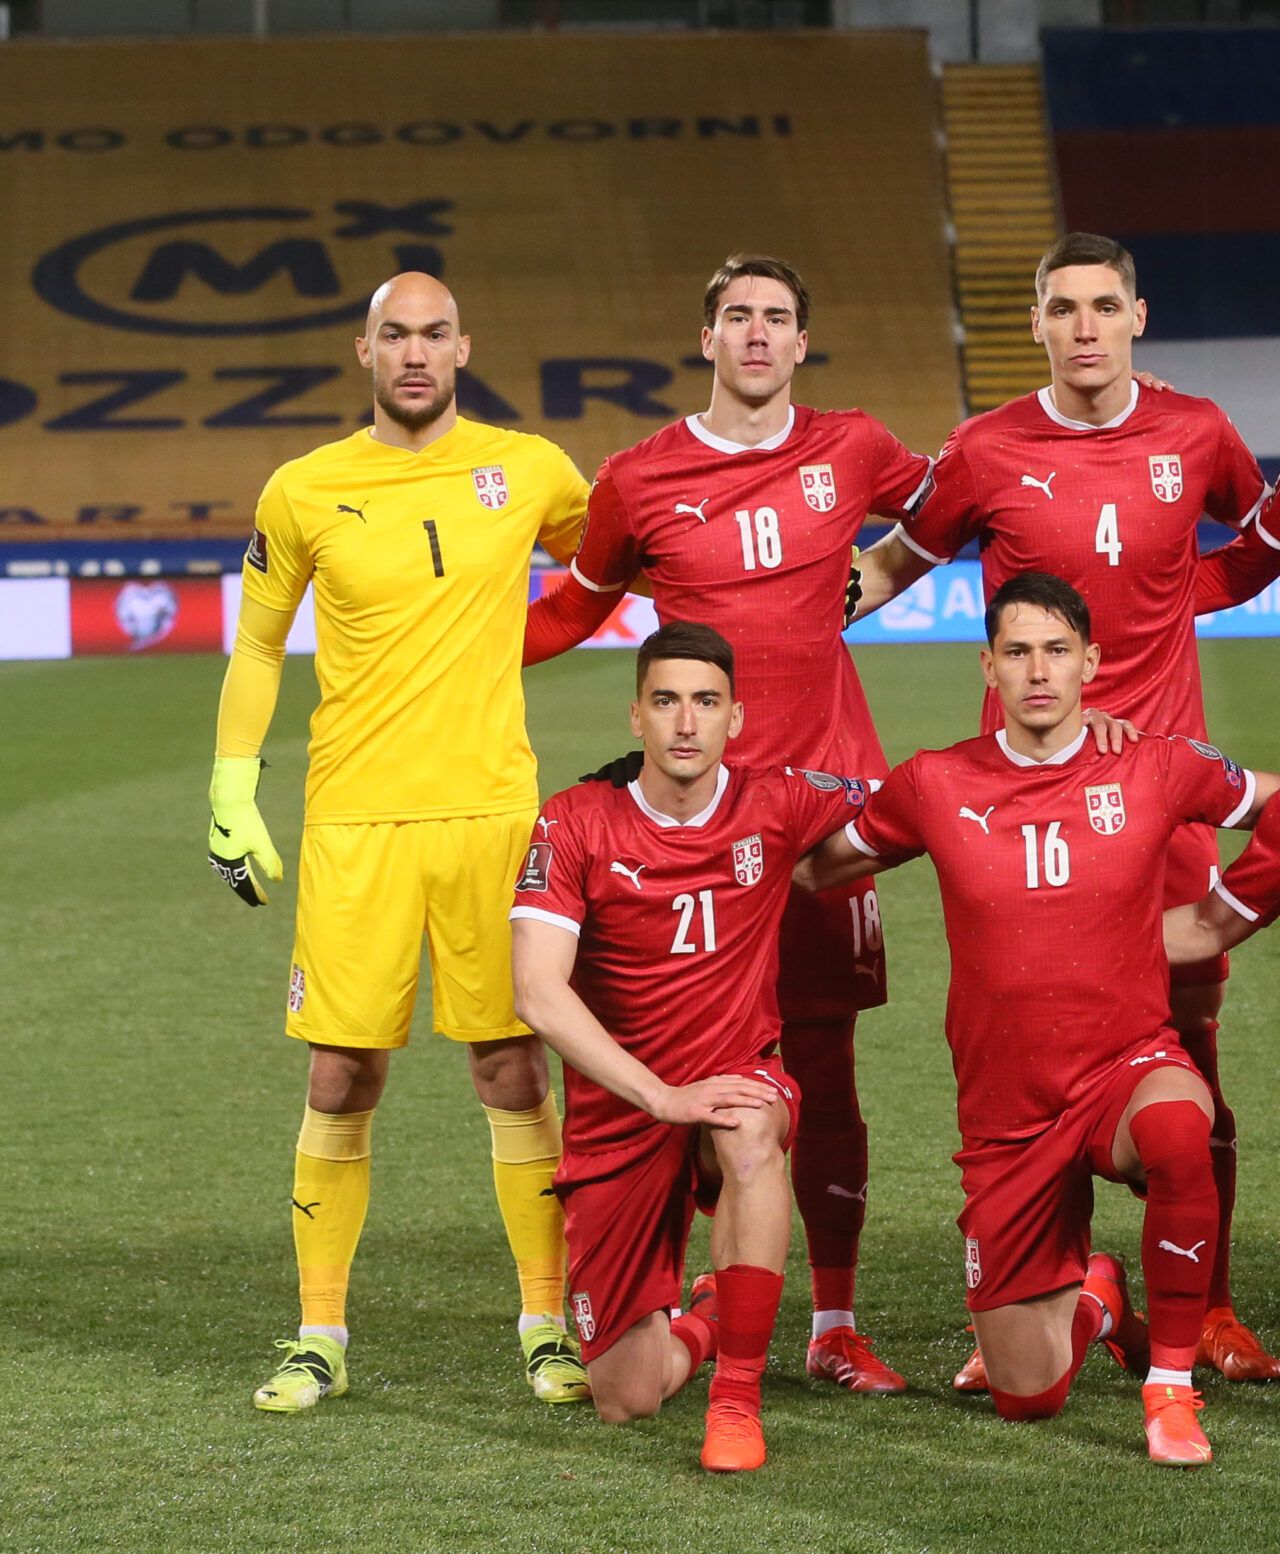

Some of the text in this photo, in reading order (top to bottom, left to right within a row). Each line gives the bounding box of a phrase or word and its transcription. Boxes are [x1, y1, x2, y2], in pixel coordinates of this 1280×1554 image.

[166, 115, 793, 151] ODGOVORNI
[422, 519, 445, 578] 1
[735, 506, 783, 571] 18
[1095, 503, 1123, 567] 4
[1021, 821, 1071, 889] 16
[669, 889, 717, 954] 21
[848, 889, 882, 958] 18
